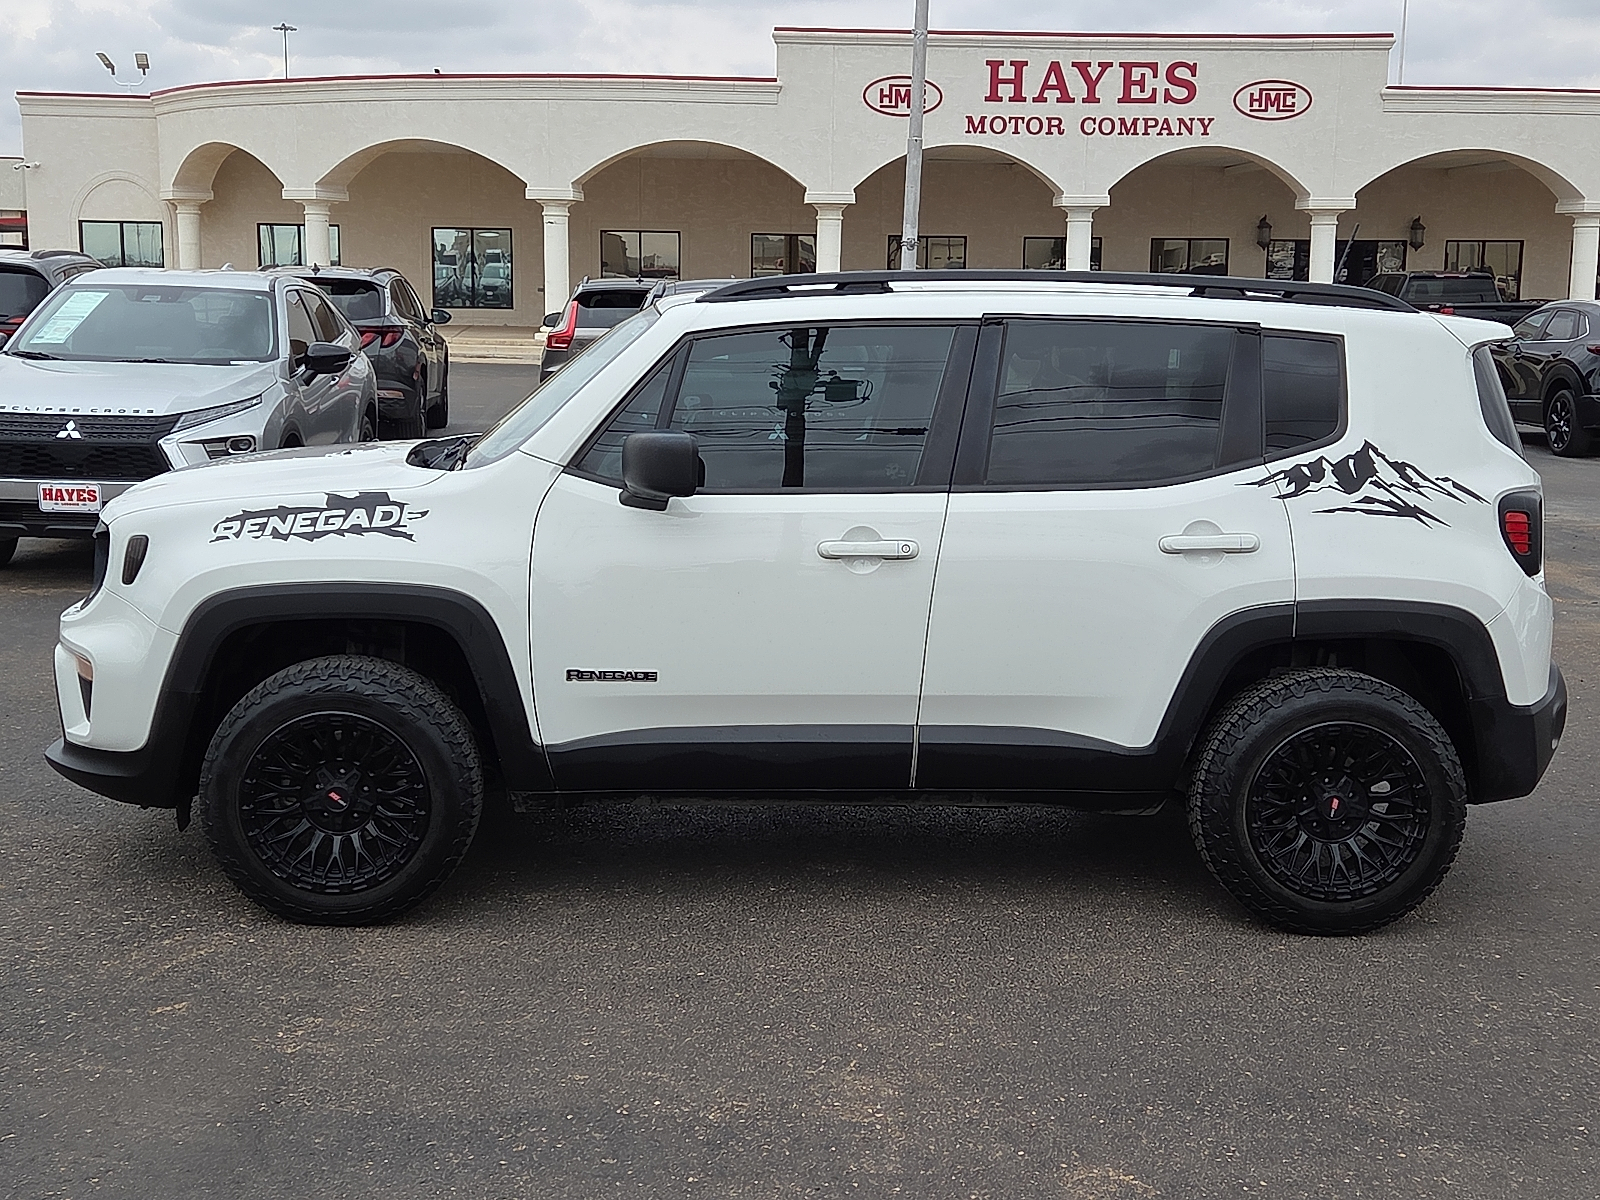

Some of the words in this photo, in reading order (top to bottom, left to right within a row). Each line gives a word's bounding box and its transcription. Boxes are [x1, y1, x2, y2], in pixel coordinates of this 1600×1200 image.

[985, 60, 1198, 104] HAYES
[879, 84, 926, 109] HM
[1249, 88, 1296, 112] HMC
[965, 116, 1065, 135] MOTOR
[1080, 117, 1215, 136] COMPANY
[41, 488, 98, 502] HAYES
[209, 503, 429, 543] RENEGADE
[566, 669, 658, 682] RENEGADE
